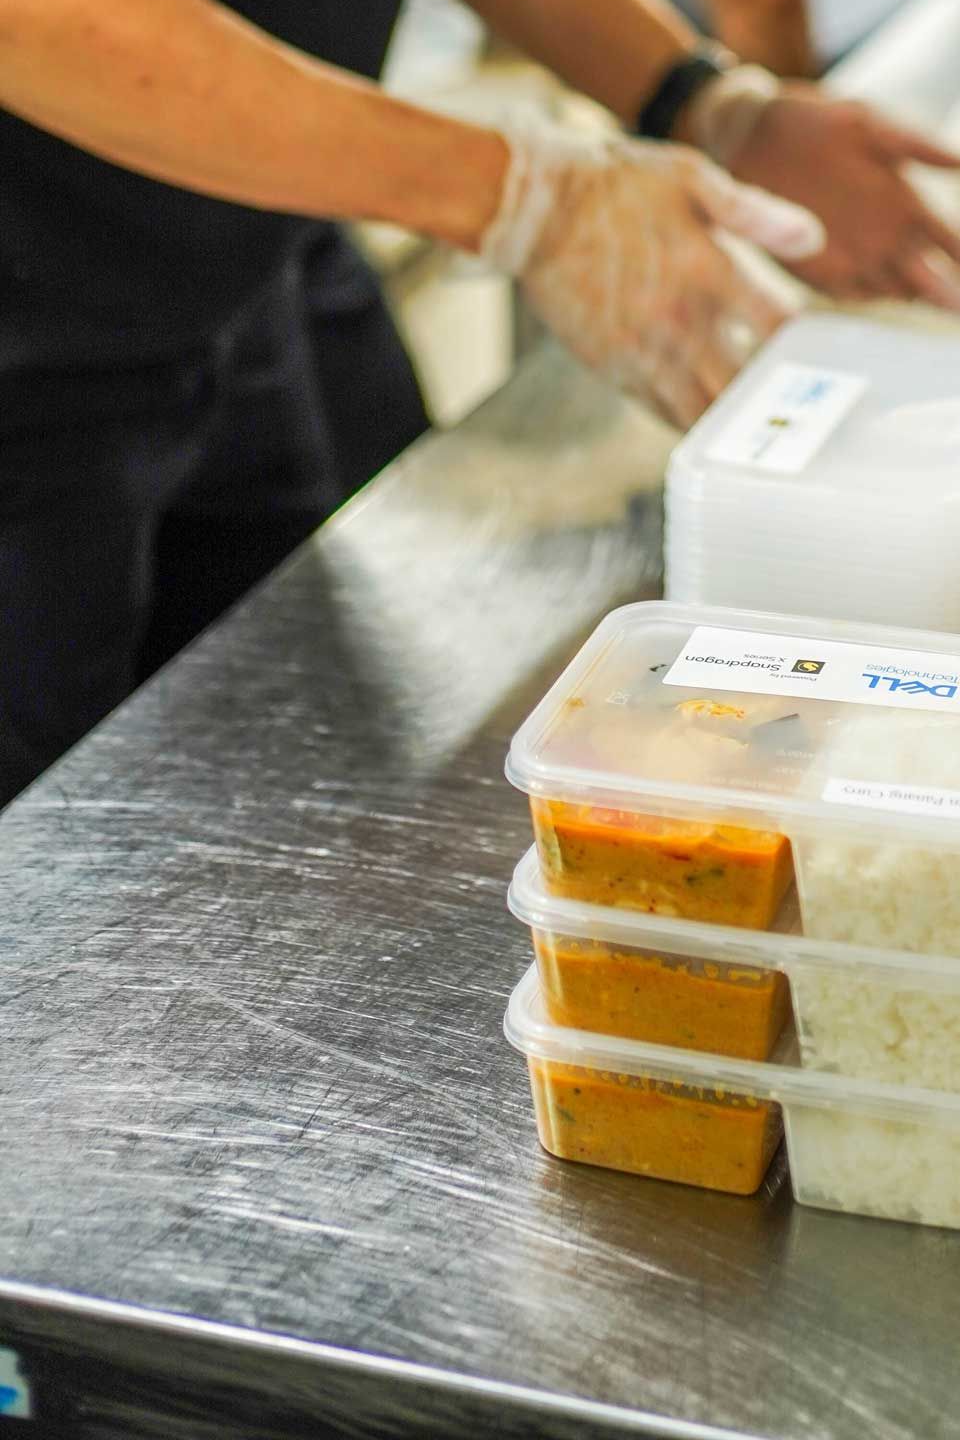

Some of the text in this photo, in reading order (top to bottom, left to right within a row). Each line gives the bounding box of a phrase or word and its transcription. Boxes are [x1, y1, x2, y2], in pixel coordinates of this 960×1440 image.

[685, 654, 781, 672] Snapdragon
[743, 653, 776, 662] Series
[781, 674, 817, 682] Powered
[866, 664, 958, 684] Technologies
[862, 674, 958, 698] DELL
[840, 785, 883, 799] Curry
[888, 789, 944, 807] Panang
